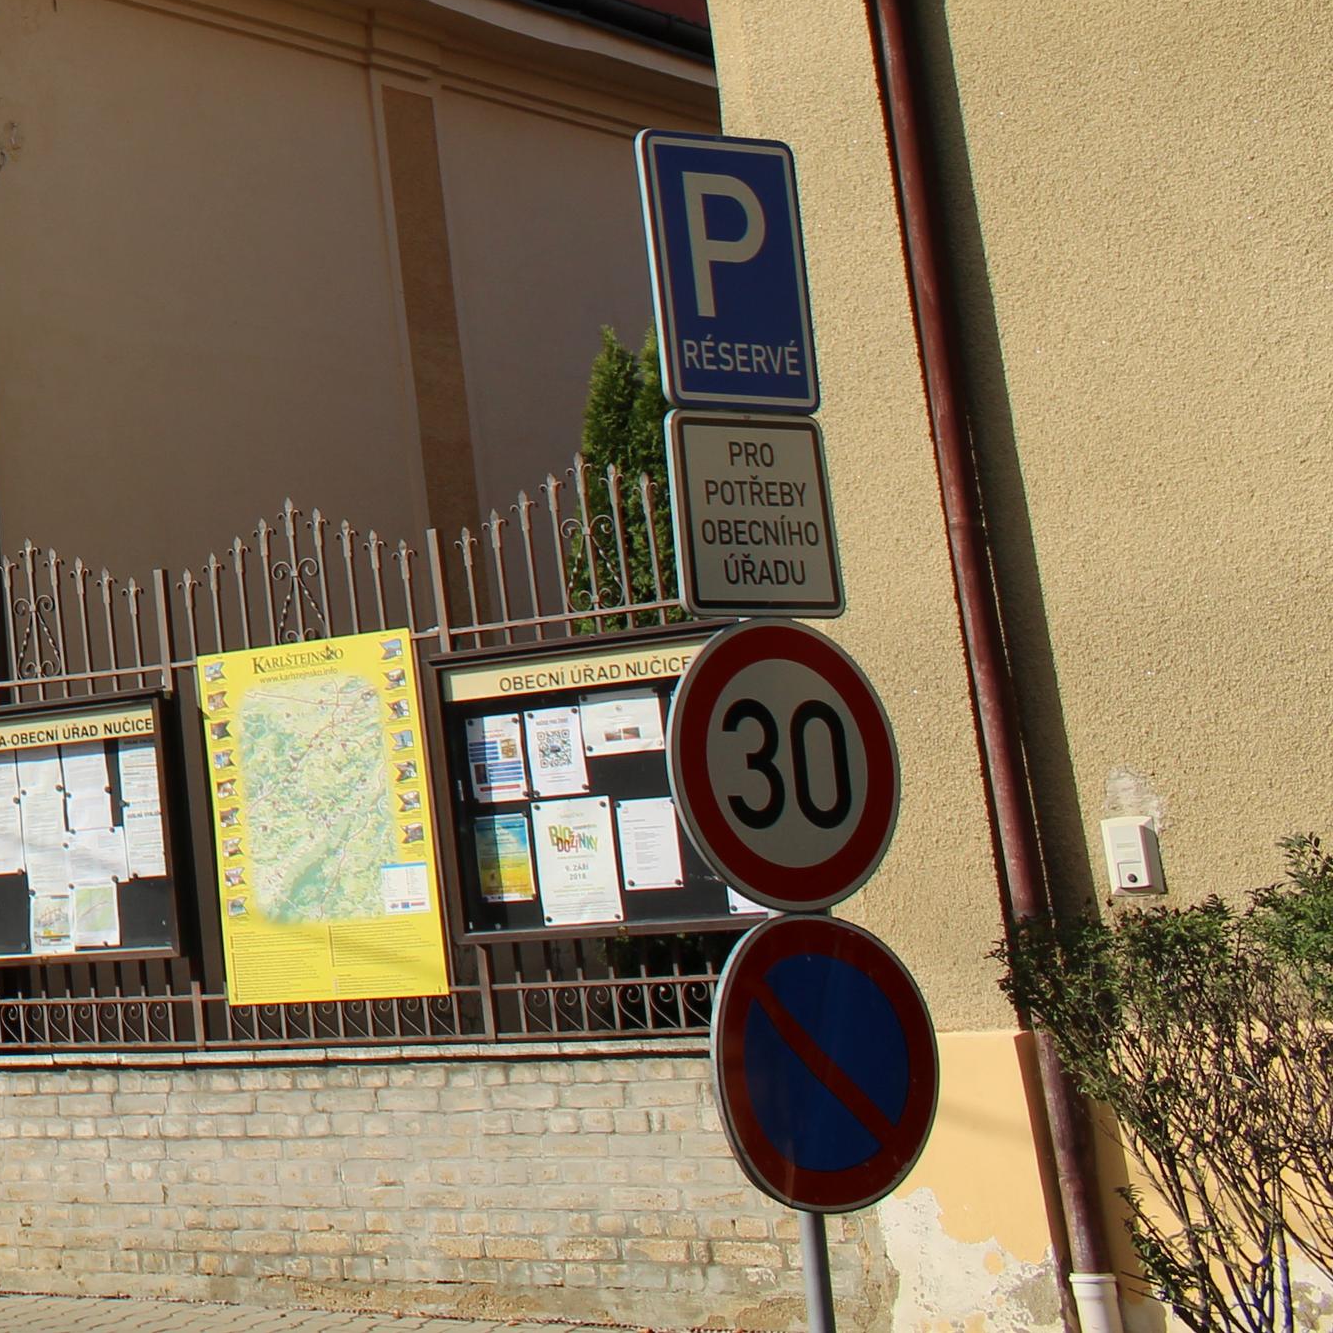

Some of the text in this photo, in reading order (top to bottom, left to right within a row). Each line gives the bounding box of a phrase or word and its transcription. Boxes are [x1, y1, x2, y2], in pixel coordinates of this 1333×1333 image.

[681, 170, 767, 318] P
[682, 334, 802, 377] RÉSERVÉ
[727, 441, 775, 468] PRO
[704, 474, 808, 509] POTŘEBY
[700, 515, 820, 548] OBECNÍHO
[723, 553, 807, 587] ÚŘADU
[499, 668, 566, 693] OBECNÍ
[570, 663, 621, 685] ÚŘAD
[63, 721, 99, 741] ÚŘAD
[103, 717, 154, 736] NUČICE
[721, 697, 853, 830] 30
